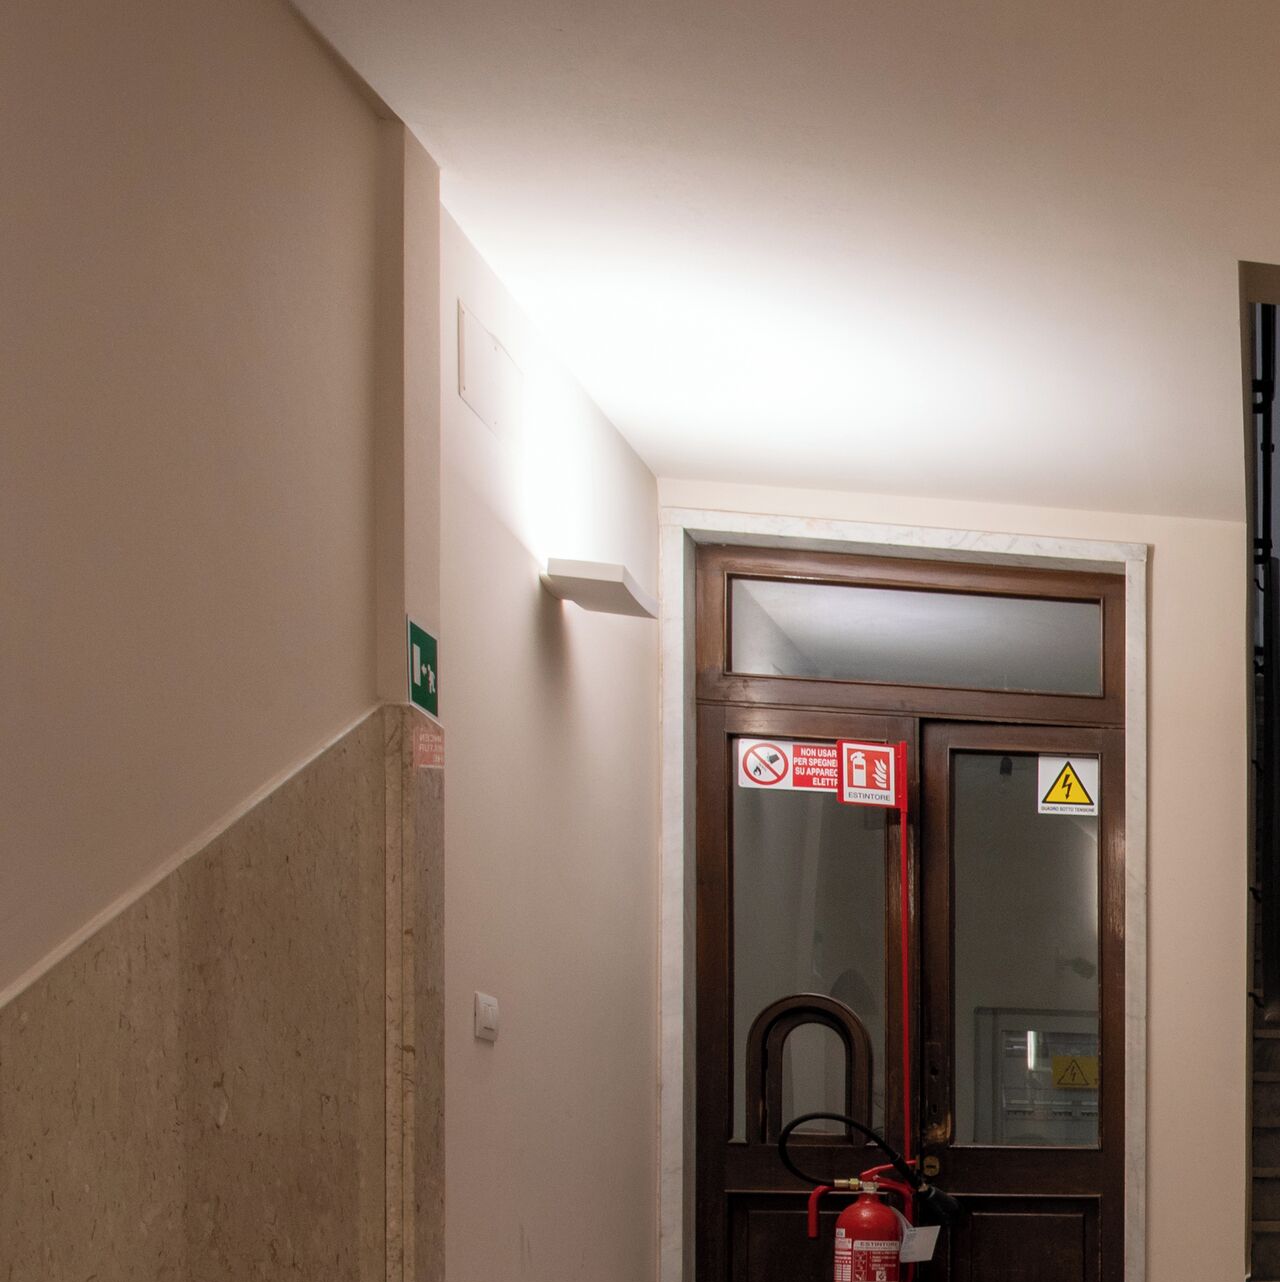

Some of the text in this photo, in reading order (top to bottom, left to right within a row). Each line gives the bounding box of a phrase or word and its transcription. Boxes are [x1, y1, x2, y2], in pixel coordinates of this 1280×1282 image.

[800, 747, 817, 757] NON
[793, 757, 838, 768] PER SPEGNE
[795, 767, 805, 776] SU
[848, 791, 891, 802] ESTINTORE
